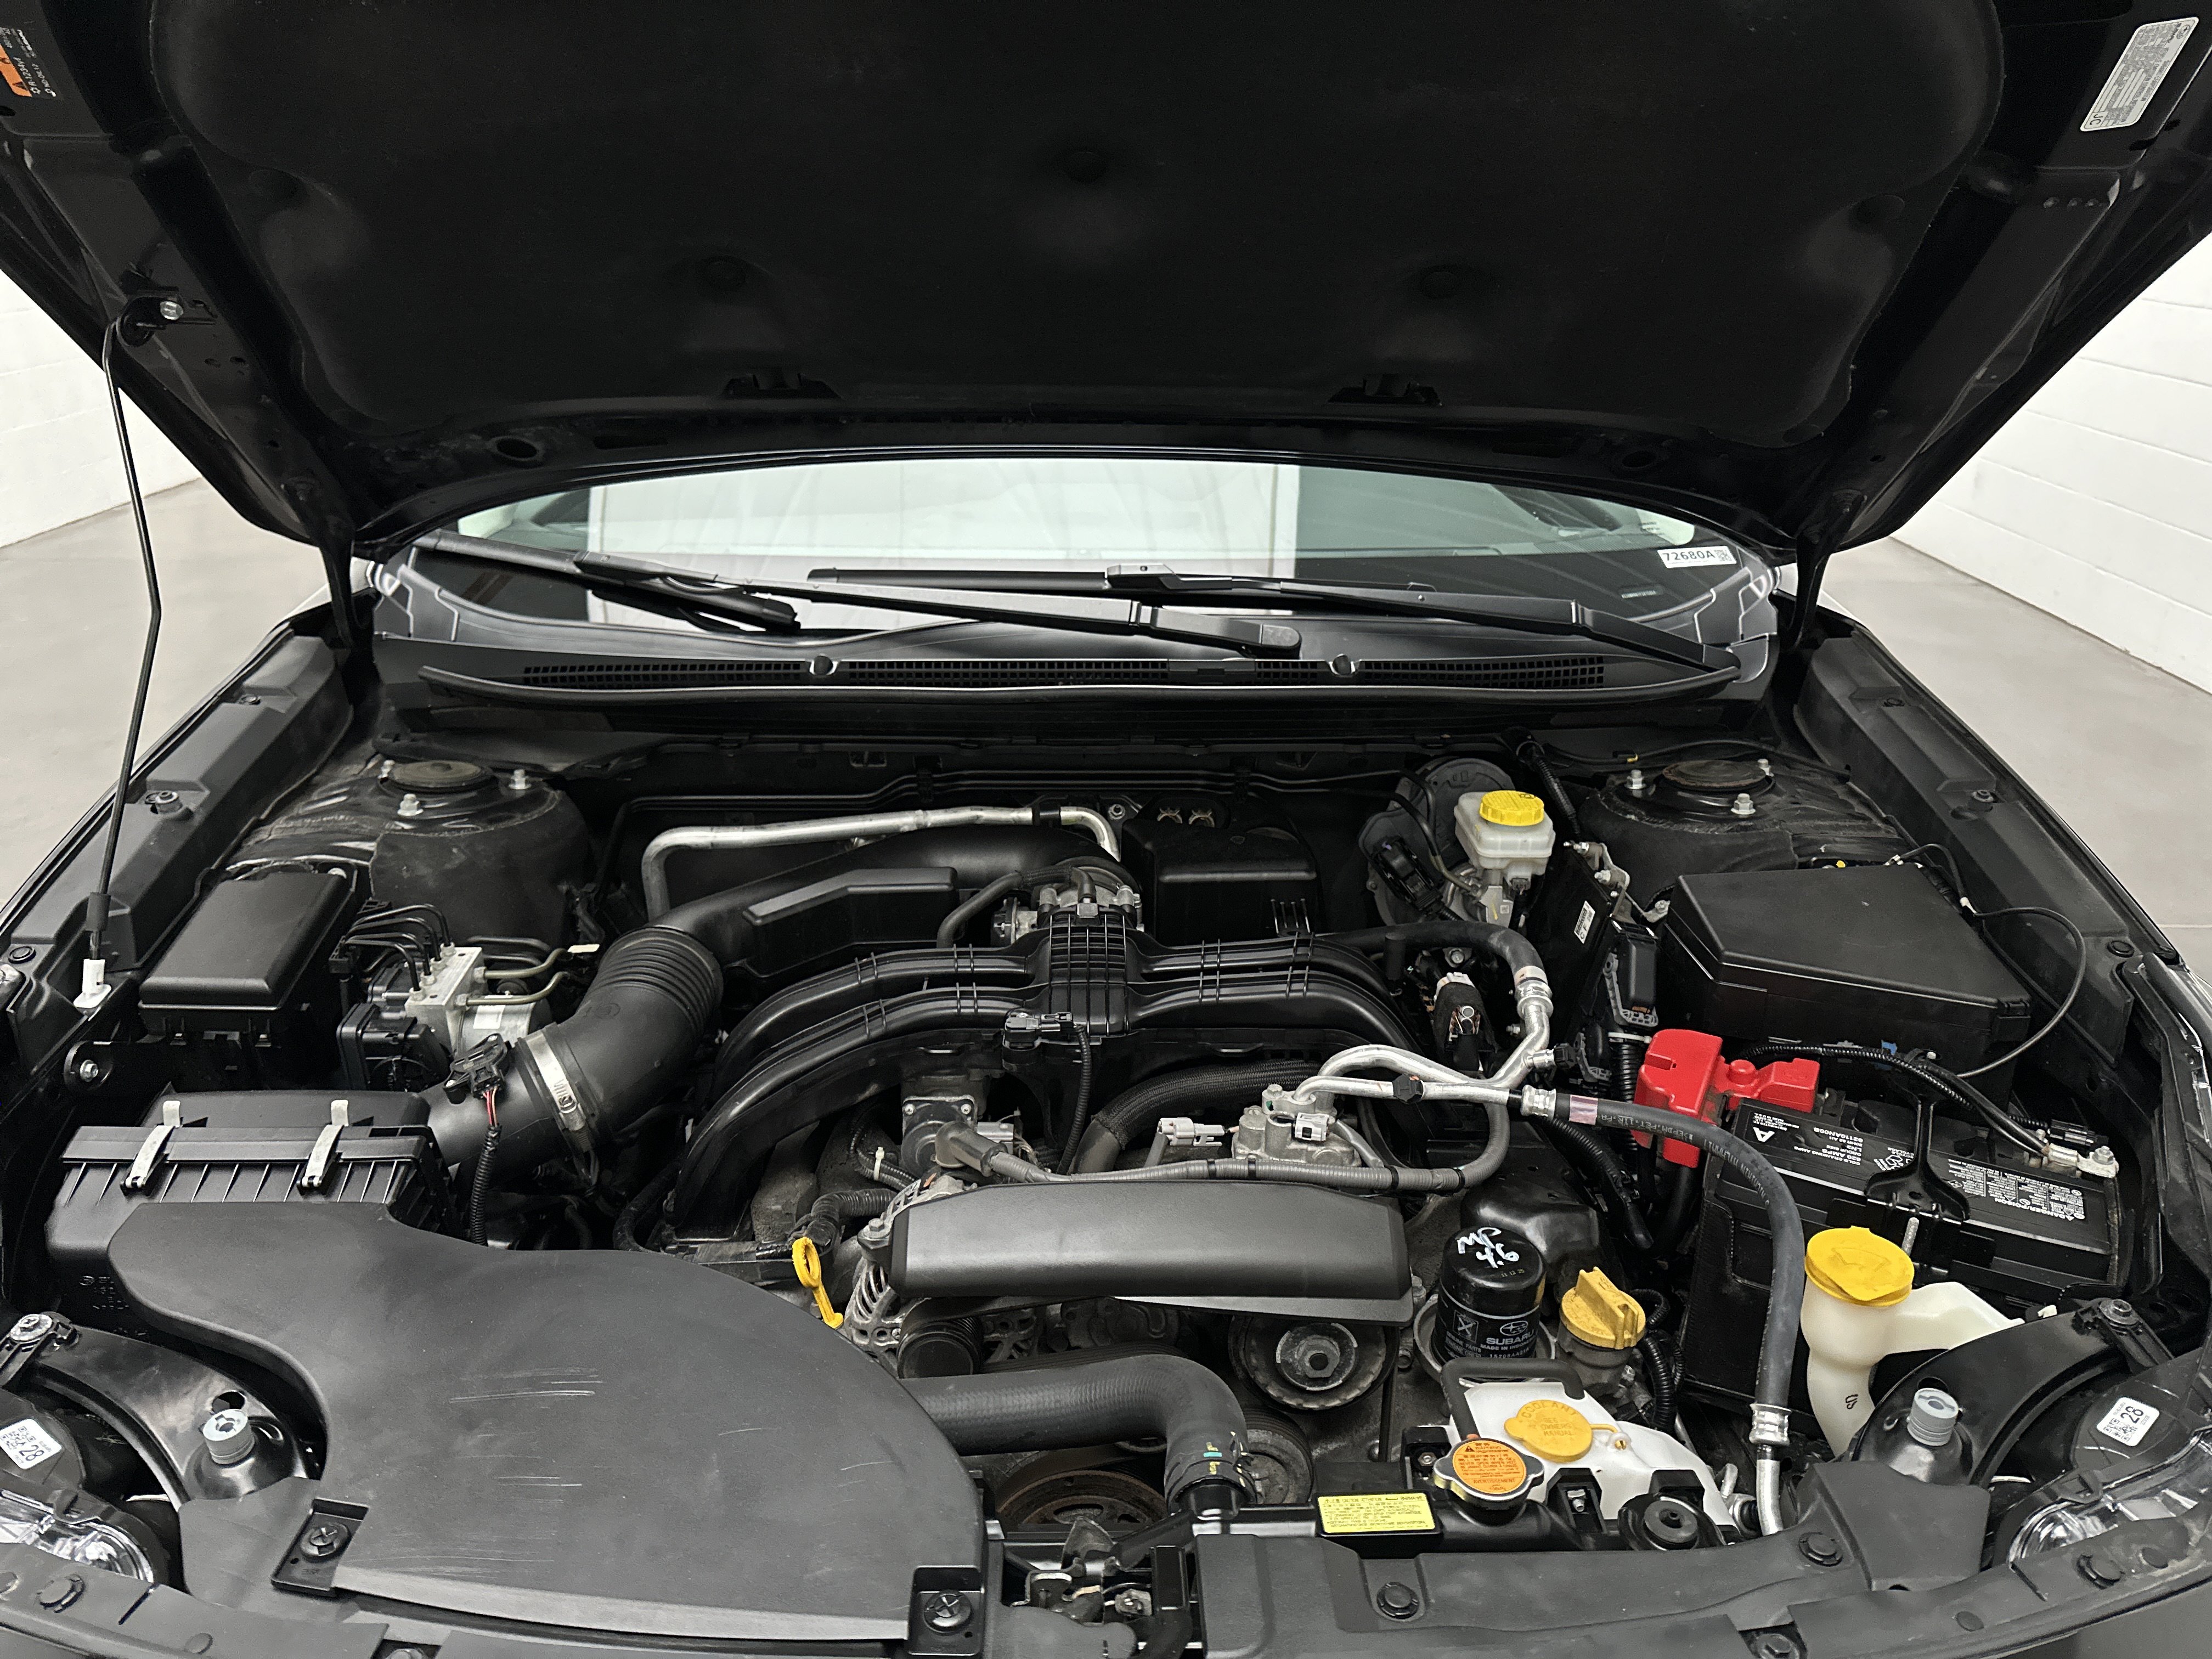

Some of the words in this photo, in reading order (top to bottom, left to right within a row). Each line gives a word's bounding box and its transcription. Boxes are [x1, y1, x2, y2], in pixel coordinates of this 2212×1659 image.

[1662, 550, 1715, 561] 72680A
[1793, 1146, 1811, 1154] AMPS
[1812, 1150, 1843, 1161] CRANKING
[1821, 1148, 1846, 1158] AMPS
[1840, 1148, 1862, 1156] GROUP
[1994, 1197, 2066, 1219] DANGER/POISON
[1486, 1328, 1534, 1345] SUBARU
[1465, 1343, 1482, 1353] PARTS
[1521, 1401, 1579, 1418] COOLANT
[2120, 1406, 2144, 1424] 28
[19, 1444, 44, 1461] 28
